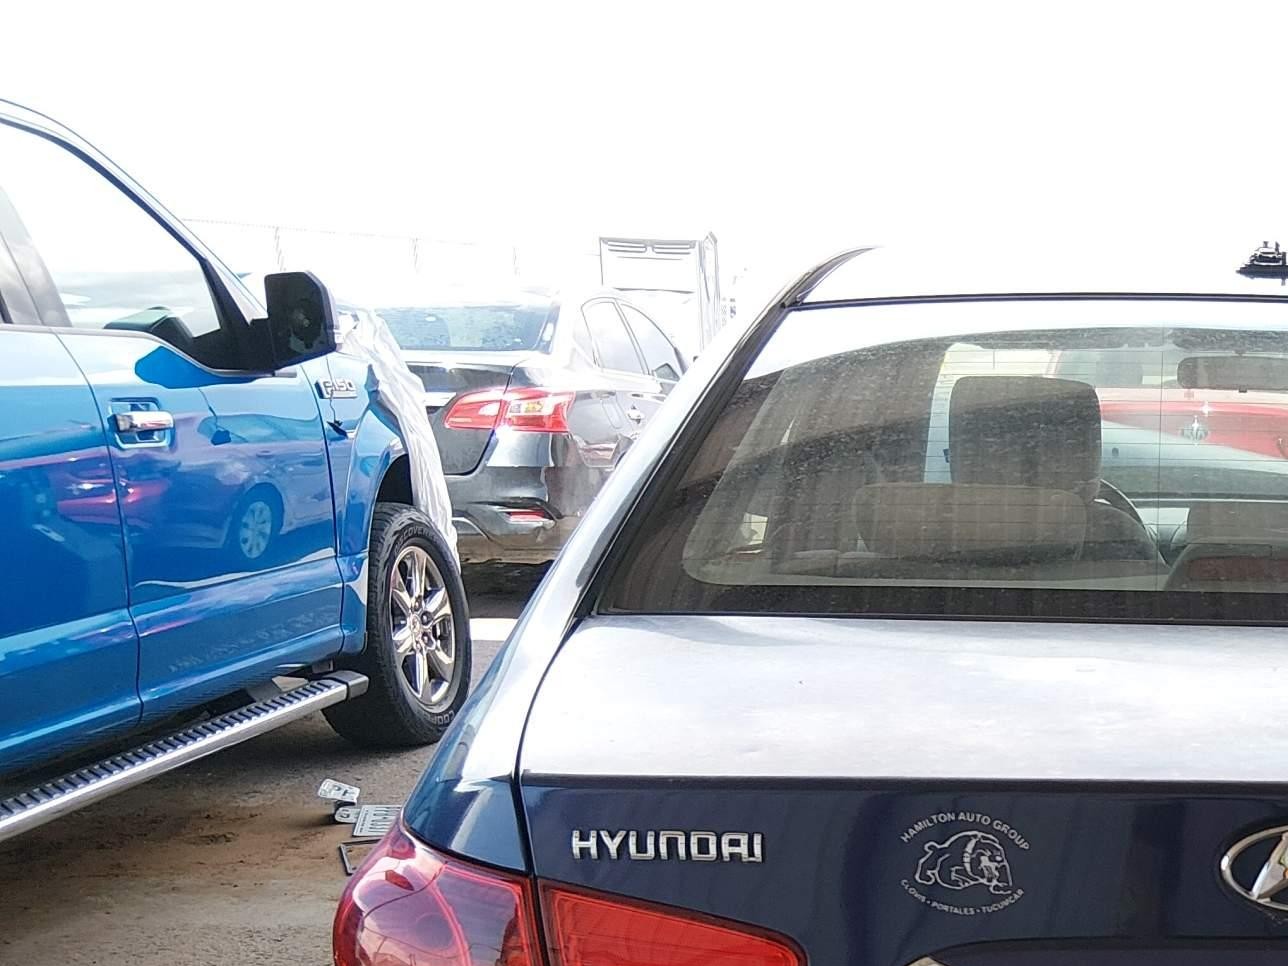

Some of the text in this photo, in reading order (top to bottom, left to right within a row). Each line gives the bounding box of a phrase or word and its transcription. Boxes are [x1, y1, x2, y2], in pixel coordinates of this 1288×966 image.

[571, 829, 764, 863] HYUNDAI
[900, 811, 1030, 851] HAMILTON AUTO GROUP
[931, 901, 975, 916] PORTALES
